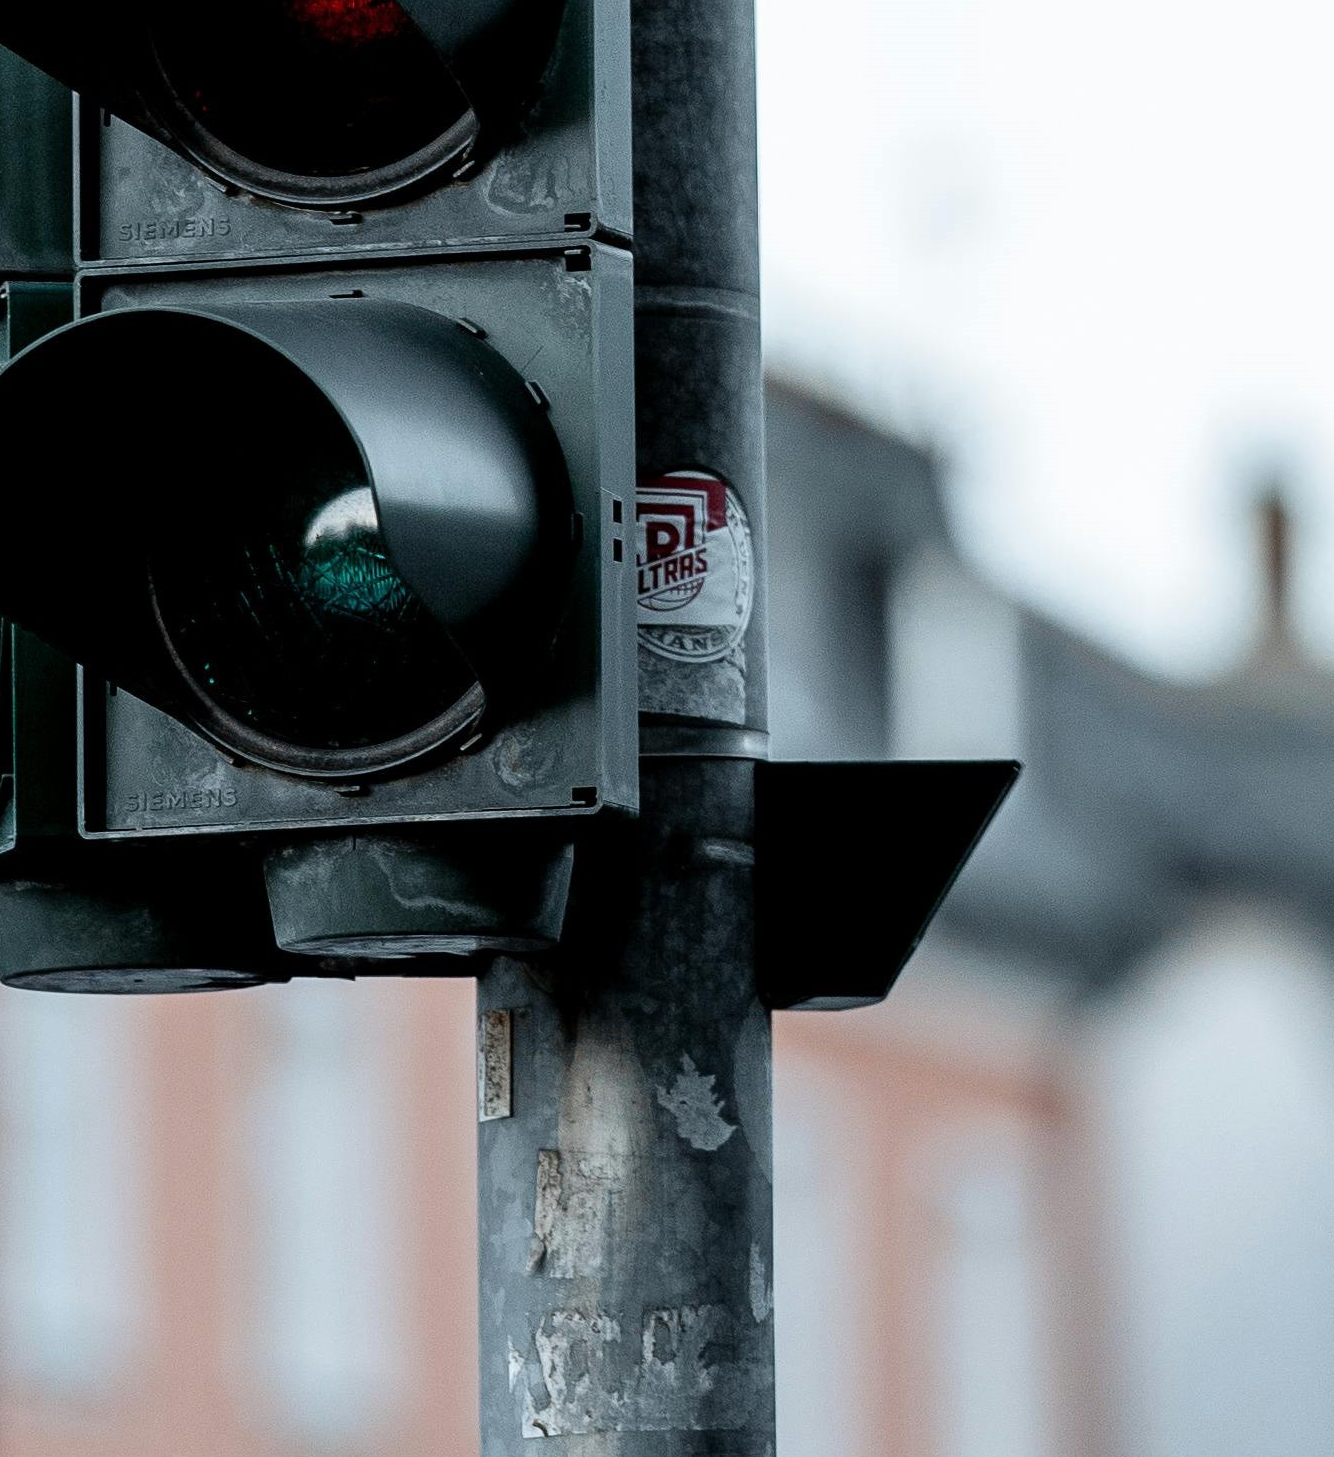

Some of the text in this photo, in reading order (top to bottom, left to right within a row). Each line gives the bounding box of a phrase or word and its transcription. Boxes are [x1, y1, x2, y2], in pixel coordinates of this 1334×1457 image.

[119, 217, 232, 242] SIEMENS
[638, 547, 708, 595] LTRAS
[125, 788, 239, 812] SIEMENS
